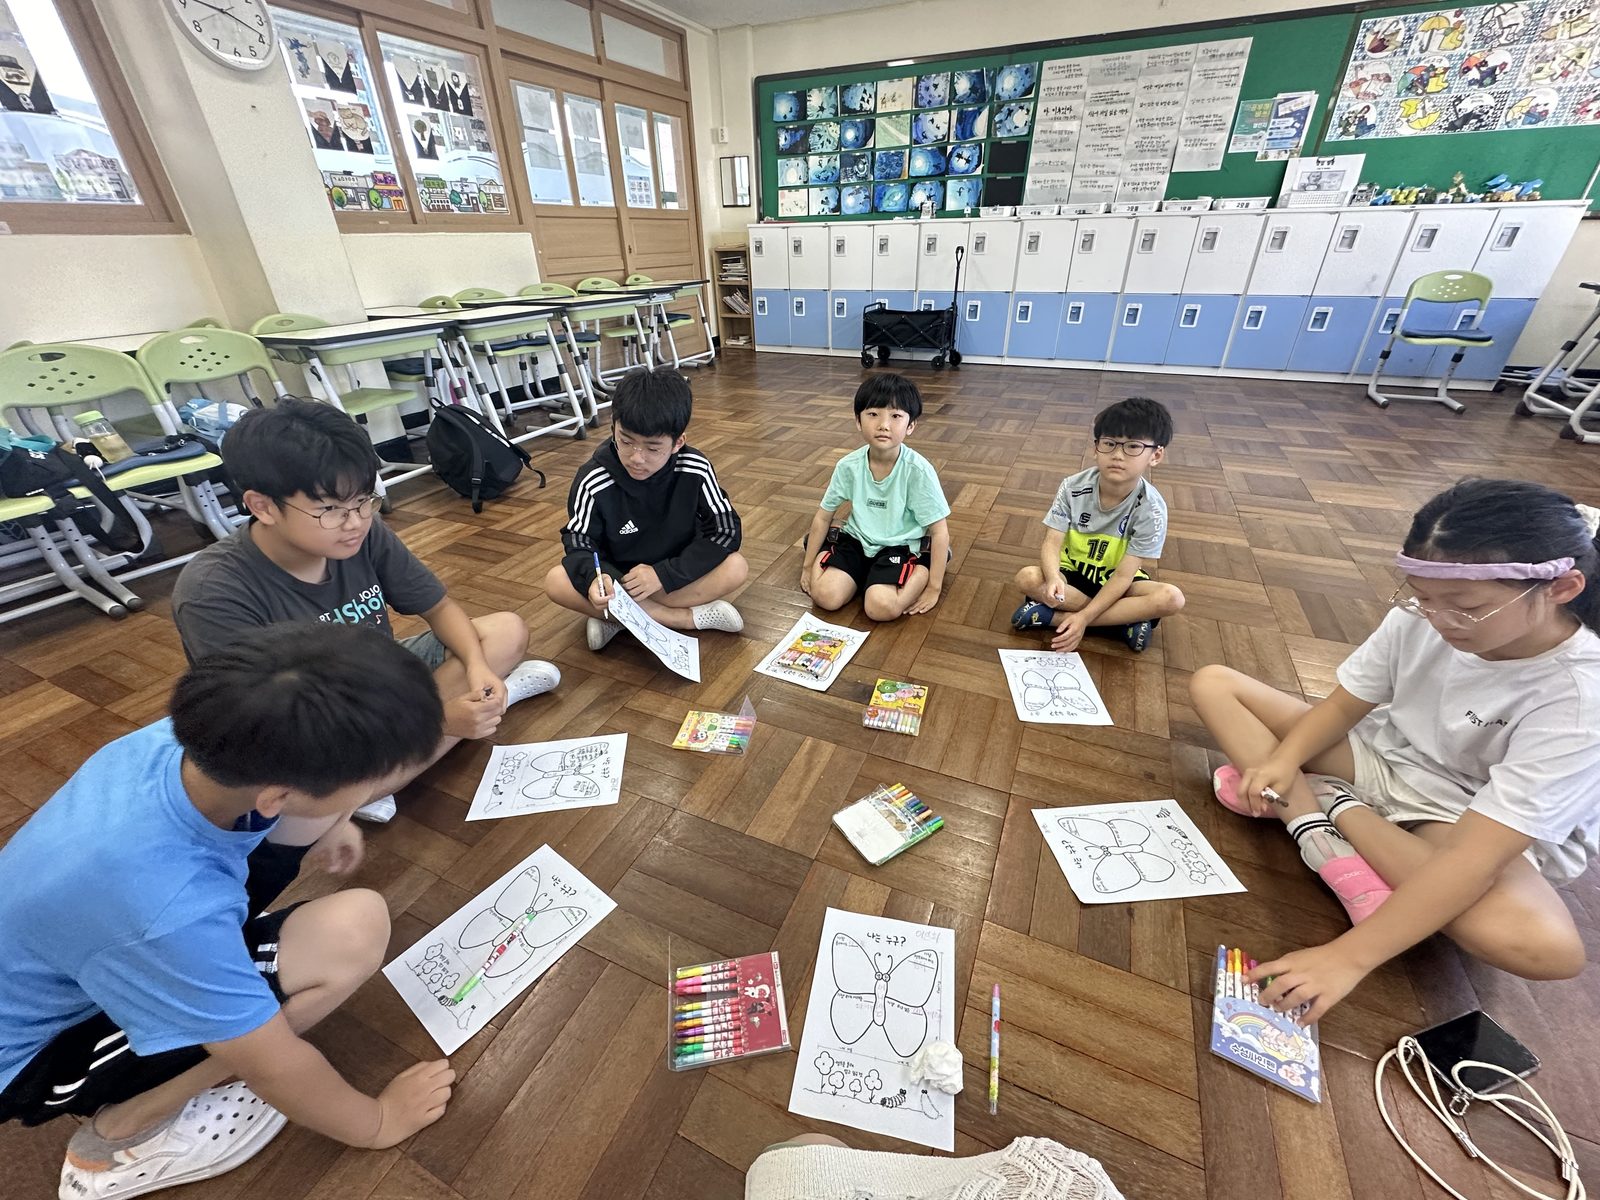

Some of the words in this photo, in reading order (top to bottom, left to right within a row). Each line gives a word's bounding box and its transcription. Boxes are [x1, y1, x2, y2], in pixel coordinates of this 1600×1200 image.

[255, 14, 264, 26] 3
[192, 20, 202, 33] 8
[212, 37, 220, 49] 7
[258, 34, 265, 45] 4
[233, 48, 242, 57] 6
[248, 46, 257, 57] 5
[619, 526, 639, 535] adidas
[358, 584, 381, 603] JOJO
[551, 874, 562, 887] 나는
[559, 884, 577, 898] 누구?
[866, 932, 882, 943] 나는
[885, 935, 907, 946] 누구?
